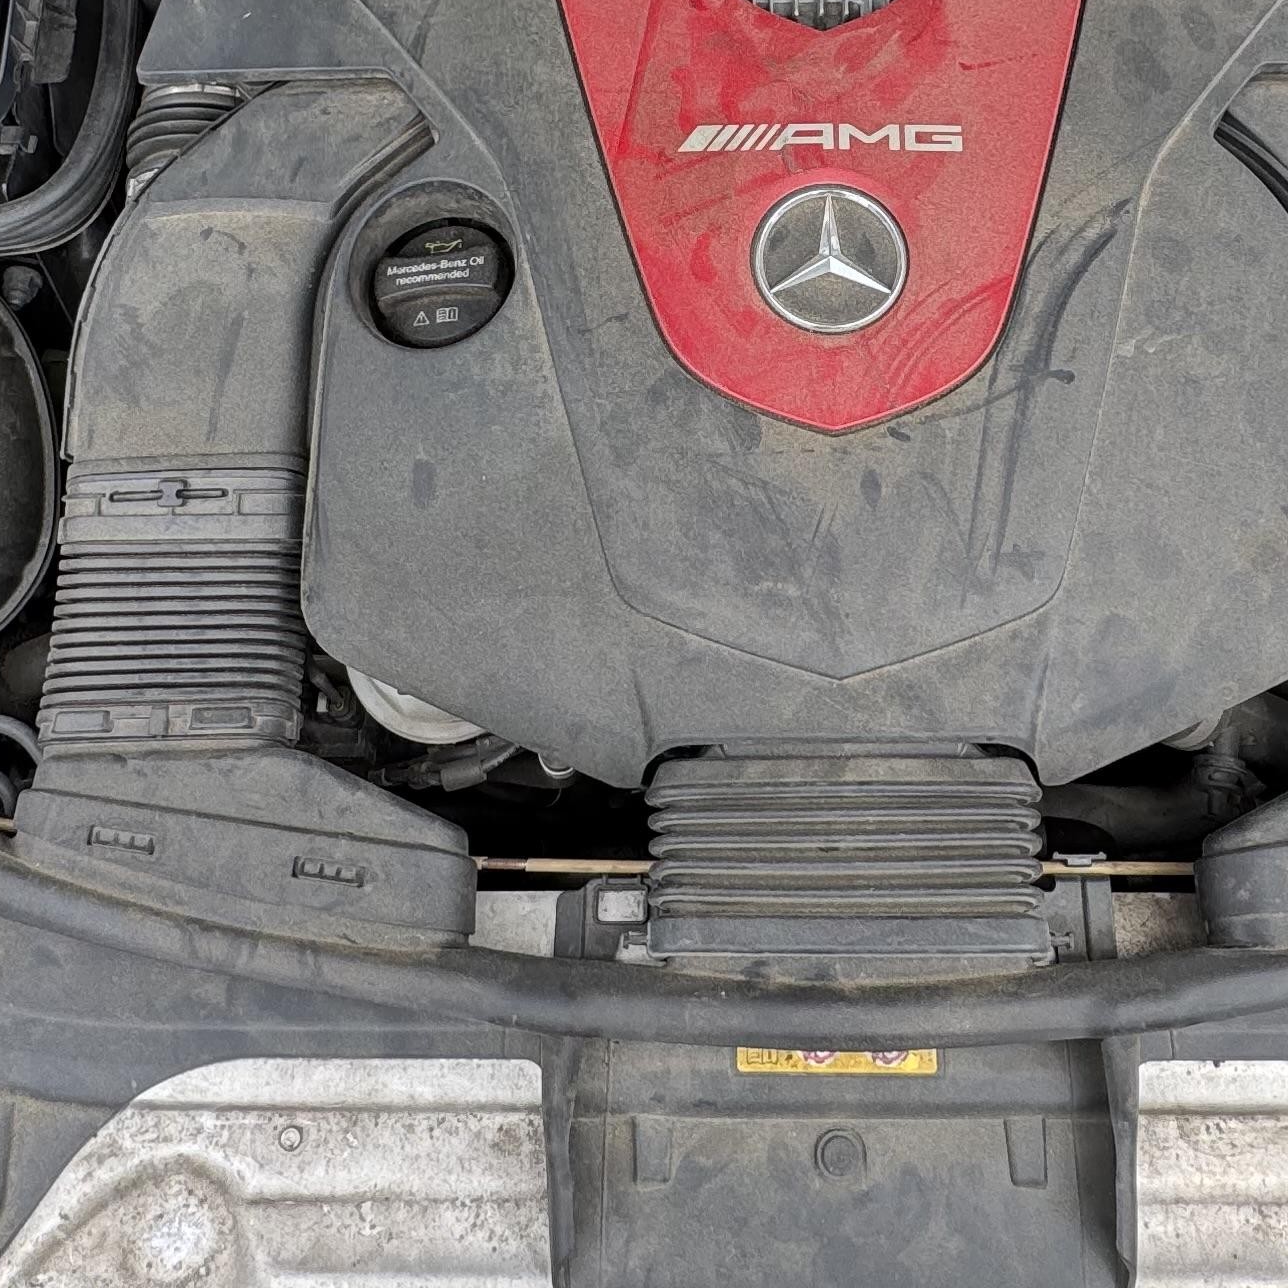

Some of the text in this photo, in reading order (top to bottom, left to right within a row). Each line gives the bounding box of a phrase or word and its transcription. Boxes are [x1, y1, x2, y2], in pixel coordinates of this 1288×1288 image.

[769, 123, 963, 152] AMG
[387, 256, 484, 276] Mercedes-Benz Oil
[395, 268, 470, 285] recommended
